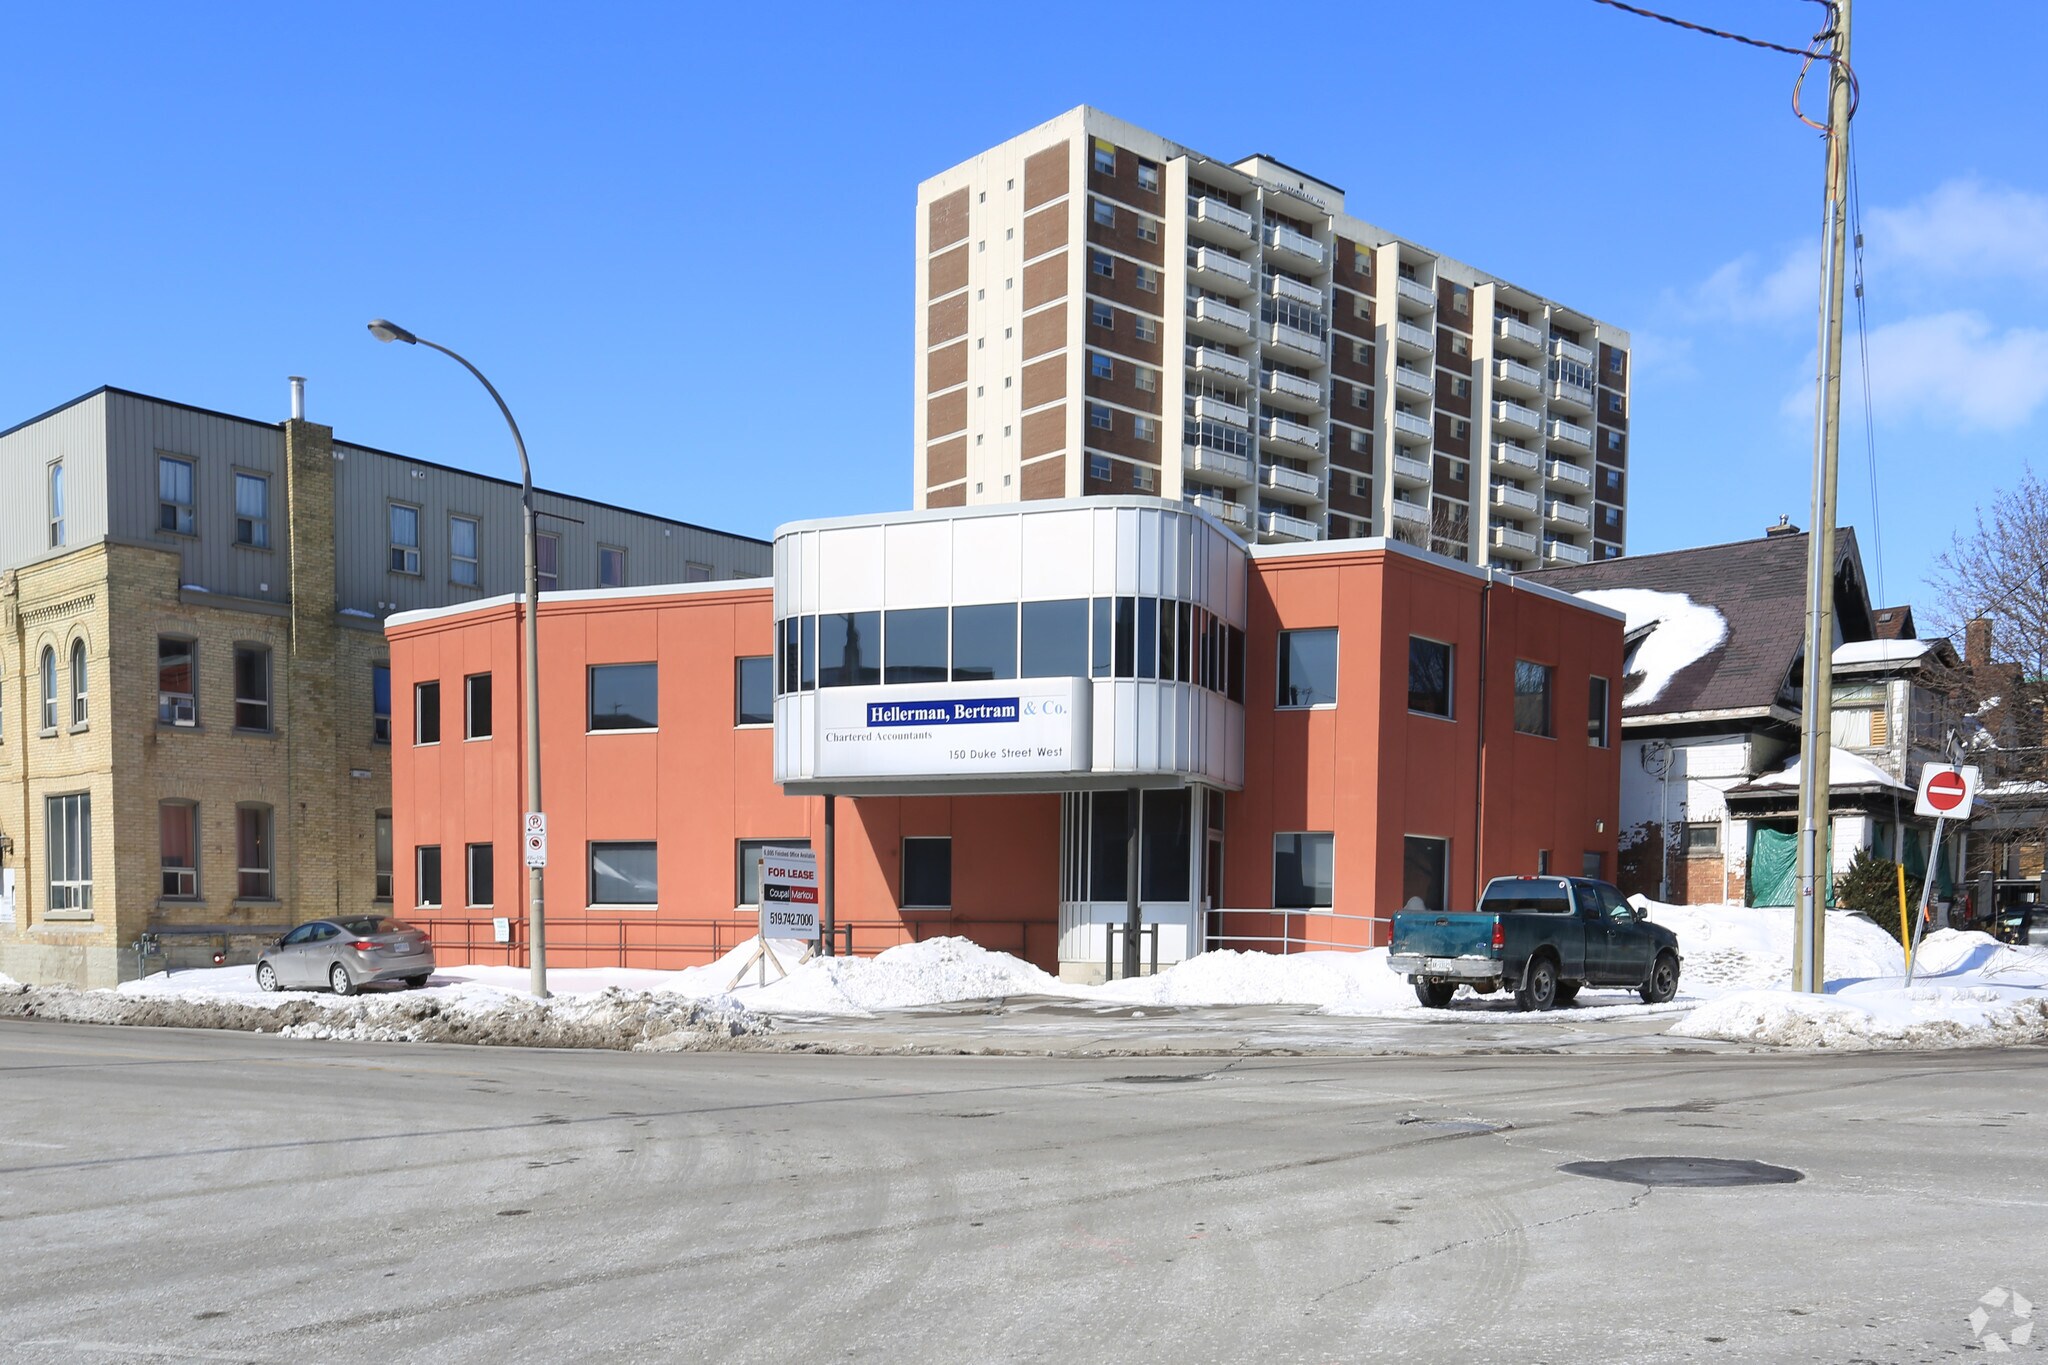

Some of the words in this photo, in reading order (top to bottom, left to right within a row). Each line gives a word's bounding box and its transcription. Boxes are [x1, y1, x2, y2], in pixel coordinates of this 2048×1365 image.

[871, 706, 950, 723] Hellerman,
[953, 704, 1015, 720] Bertram
[1023, 700, 1037, 716] &
[1042, 699, 1067, 715] Co.
[825, 732, 872, 743] Chartered
[875, 731, 933, 741] Accountants
[949, 749, 966, 760] 150
[970, 748, 997, 759] Duke
[1001, 747, 1032, 758] Street
[1037, 746, 1063, 757] West
[768, 867, 786, 878] FOR
[788, 869, 814, 880] LEASE
[769, 888, 790, 900] Coupal
[791, 889, 814, 900] Markou
[770, 912, 814, 926] 519.742.7000
